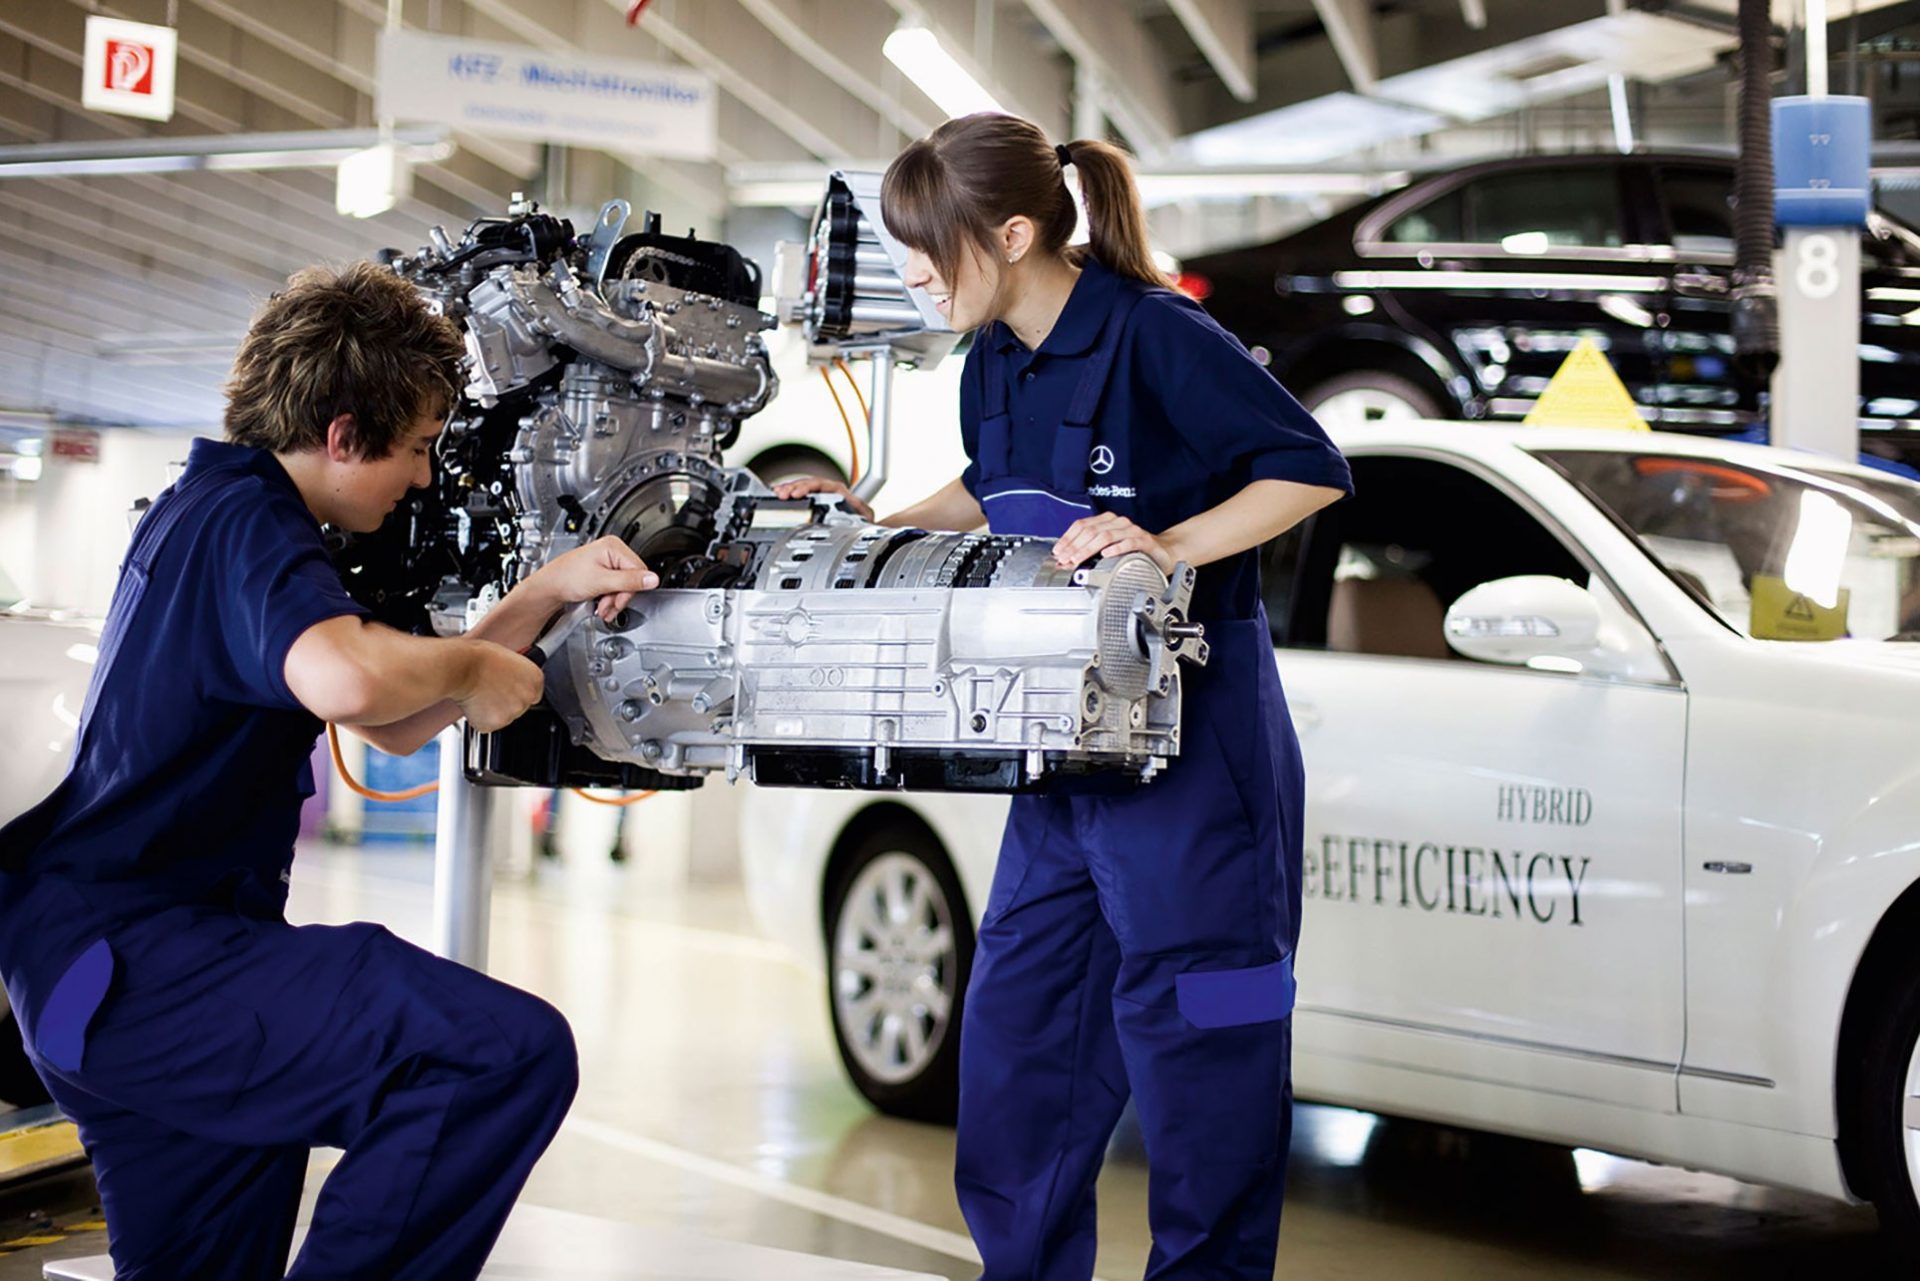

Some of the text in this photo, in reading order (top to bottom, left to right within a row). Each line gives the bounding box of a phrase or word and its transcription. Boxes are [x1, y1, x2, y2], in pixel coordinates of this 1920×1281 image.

[1797, 235, 1840, 299] 8
[1088, 484, 1136, 497] edes-Benz
[1498, 786, 1593, 826] HYBRID
[1303, 833, 1591, 925] eEFFICIENCY
